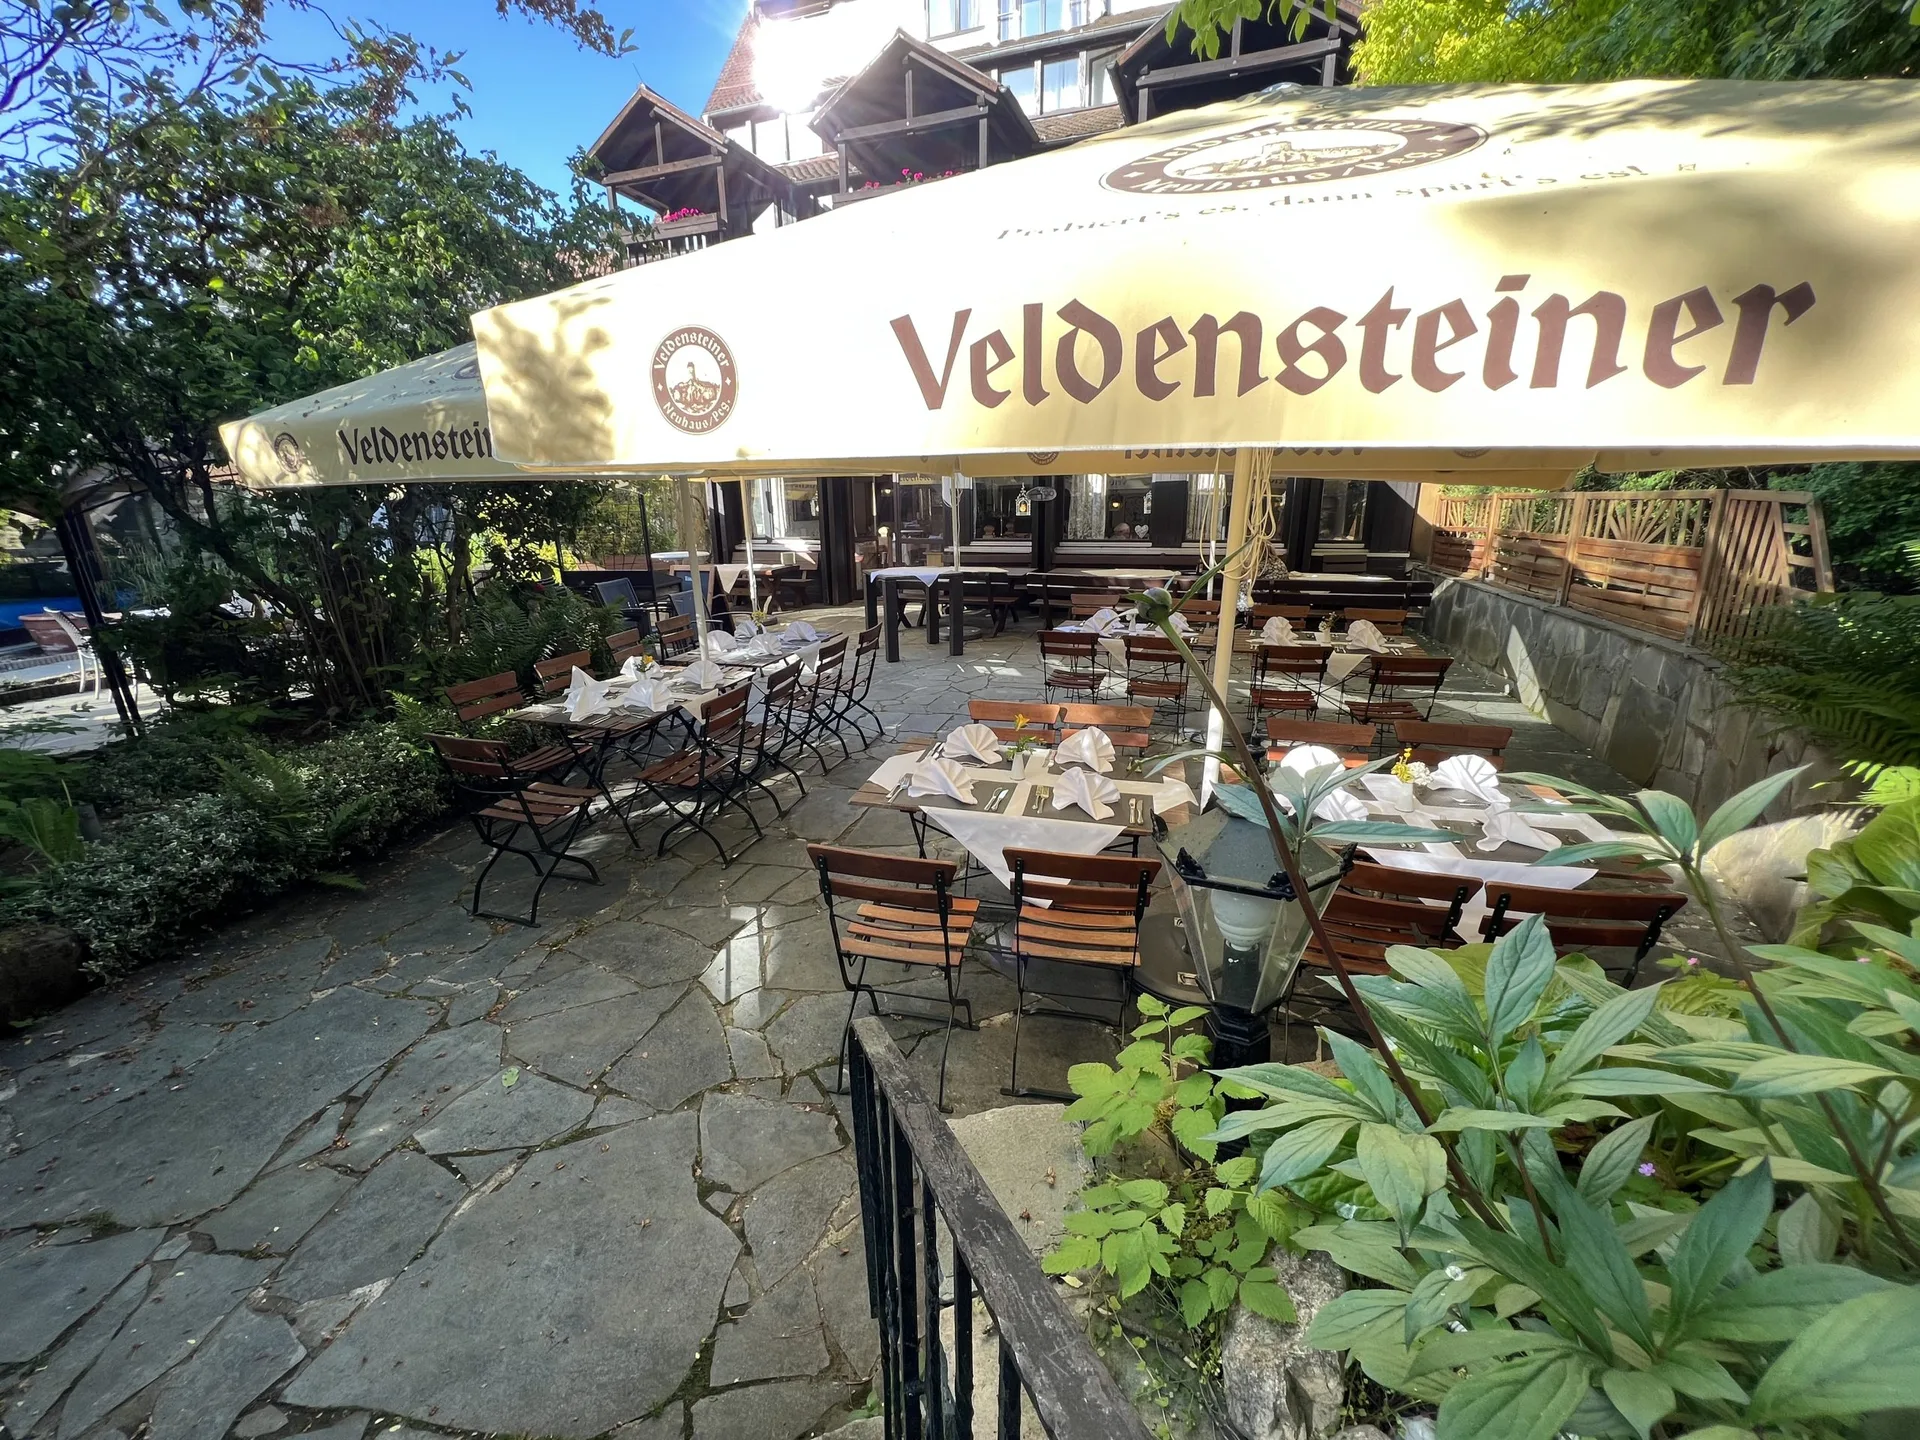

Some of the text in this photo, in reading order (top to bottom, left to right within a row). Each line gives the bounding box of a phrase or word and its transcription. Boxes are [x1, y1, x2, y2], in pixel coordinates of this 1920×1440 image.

[653, 331, 730, 369] Veldensteiner
[889, 273, 1816, 411] Veldensteiner
[338, 420, 493, 465] Veldenstei
